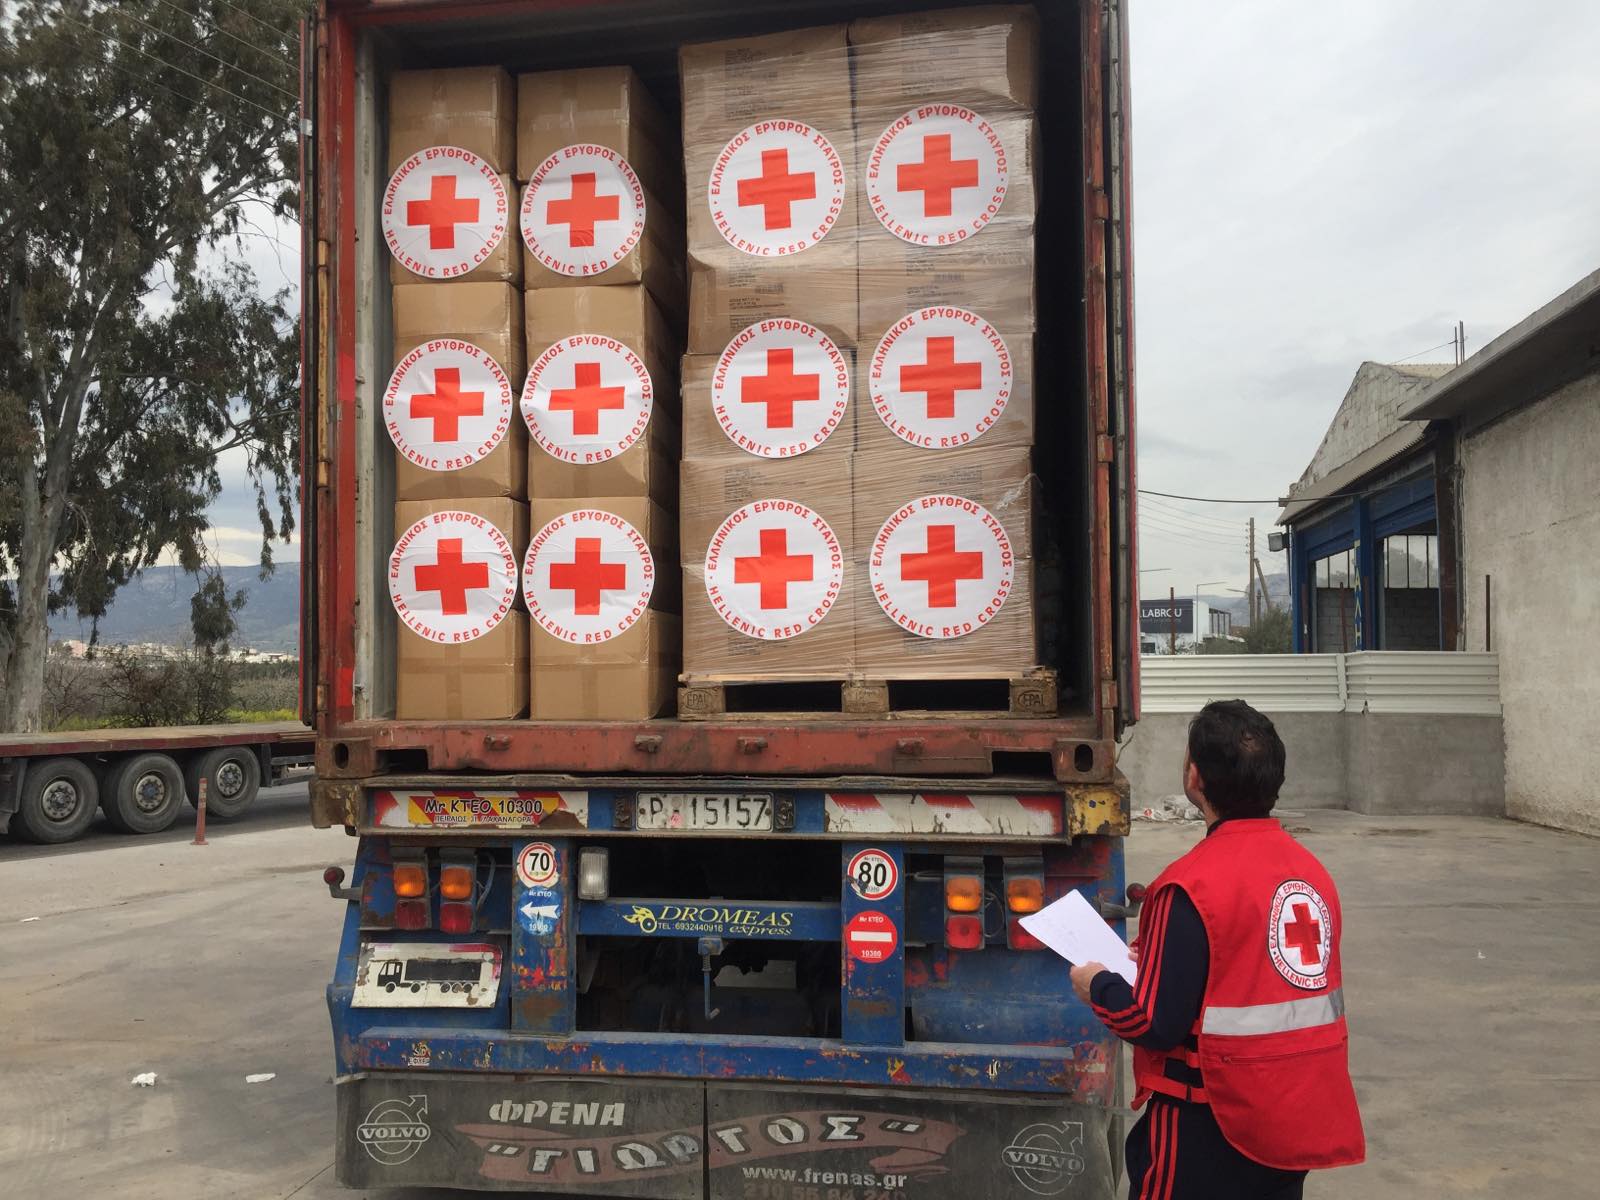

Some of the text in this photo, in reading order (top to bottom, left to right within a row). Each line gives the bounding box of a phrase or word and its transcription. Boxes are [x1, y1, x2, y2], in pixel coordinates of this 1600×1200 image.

[754, 122, 810, 137] ΕΡΥΘΡΟΣ
[813, 135, 843, 185] ΣΤΑΥΡΟΣ
[917, 106, 974, 123] ΕΡΥΘΡΟΣ
[979, 123, 1007, 173] ΣΤΑΥΡΟΣ
[425, 148, 478, 165] ΕΡΥΘΡΟΣ
[479, 164, 507, 213] ΣΤΑΥΡΟΣ
[564, 146, 615, 161] ΕΡΥΘΡΟΣ
[619, 160, 644, 209] ΣΤΑΥΡΟΣ
[715, 197, 842, 255] HELLENIC RED CROSS
[873, 186, 1005, 244] HELLENIC RED CROSS
[387, 224, 504, 277] HELLENIC RED CROSS
[525, 222, 642, 274] HELLENIC RED CROSS
[567, 336, 623, 353] ΕΡΥΘΡΟΣ
[625, 352, 651, 400] ΣΤΑΥΡΟΣ
[759, 321, 816, 338] ΕΡΥΘΡΟΣ
[818, 337, 847, 389] ΣΤΑΥΡΟΣ
[920, 309, 978, 325] ΕΡΥΘΡΟΣ
[981, 325, 1010, 377] ΣΤΑΥΡΟΣ
[426, 341, 481, 357] ΕΡΥΘΡΟΣ
[483, 356, 511, 406] ΣΤΑΥΡΟΣ
[388, 416, 509, 470] HELLENIC RED CROSS
[526, 411, 650, 463] HELLENIC RED CROSS
[717, 401, 846, 456] HELLENIC RED CROSS
[875, 390, 1009, 447] HELLENIC RED CROSS
[432, 513, 485, 529] ΕΡΥΘΡΟΣ
[488, 527, 516, 577] ΣΤΑΥΡΟΣ
[571, 512, 625, 529] ΕΡΥΘΡΟΣ
[627, 529, 653, 579] ΣΤΑΥΡΟΣ
[752, 502, 810, 519] ΕΡΥΘΡΟΣ
[812, 517, 841, 569] ΣΤΑΥΡΟΣ
[920, 497, 979, 516] ΕΡΥΘΡΟΣ
[982, 513, 1012, 568] ΣΤΑΥΡΟΣ
[393, 587, 514, 642] HELLENIC RED CROSS
[527, 591, 651, 642] HELLENIC RED CROSS
[710, 582, 840, 638] HELLENIC RED CROSS
[875, 580, 1010, 636] HELLENIC RED CROSS
[424, 799, 446, 814] Mr
[498, 799, 544, 815] 10300
[690, 797, 767, 826] 15157
[529, 852, 550, 872] 70
[858, 861, 887, 888] 80
[658, 905, 794, 927] DROMEAS
[729, 926, 793, 936] express
[1274, 954, 1312, 987] HELLENIC
[360, 1126, 428, 1140] VOLVO
[1006, 1151, 1081, 1170] VOLVO
[742, 1167, 908, 1191] www.frenas.gr
